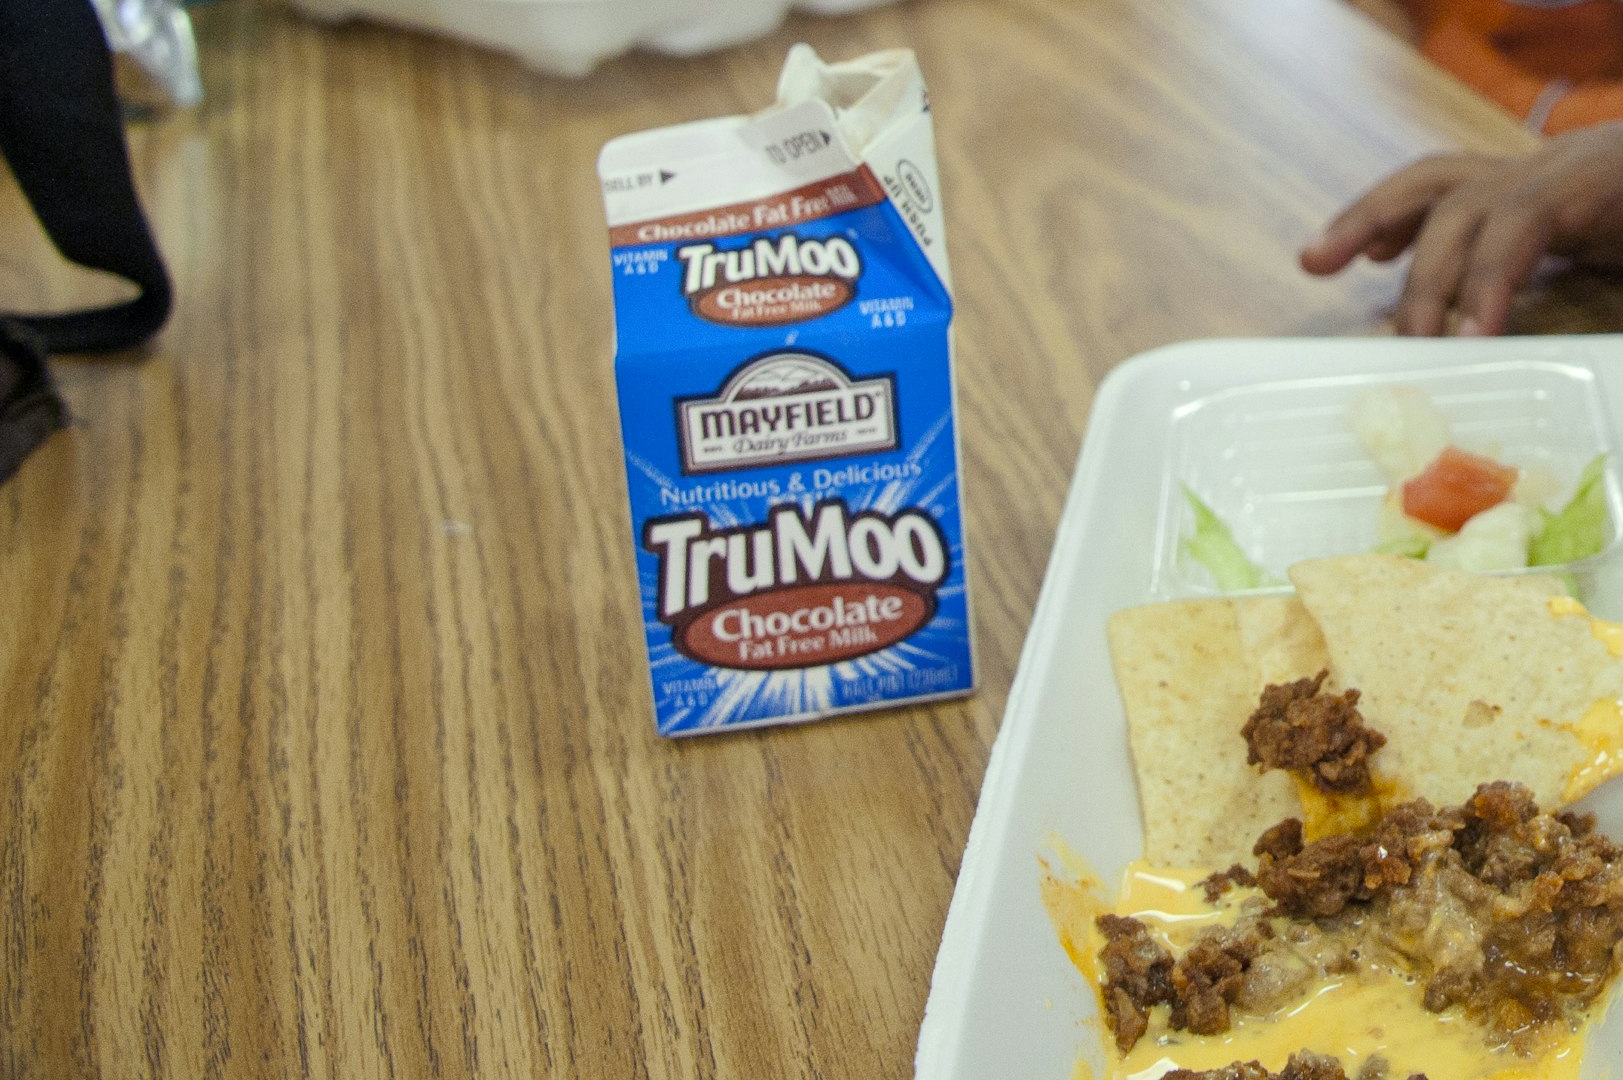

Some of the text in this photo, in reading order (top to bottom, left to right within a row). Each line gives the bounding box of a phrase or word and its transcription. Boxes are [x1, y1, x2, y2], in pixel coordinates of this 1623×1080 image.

[766, 132, 822, 165] TO OPEN
[638, 173, 654, 189] BY
[637, 213, 750, 242] Chocolate
[753, 202, 789, 227] Fat
[791, 195, 830, 219] Free
[613, 249, 668, 267] VITAMIN
[623, 263, 635, 276] A
[648, 261, 659, 274] D
[678, 233, 861, 295] TruMoo
[716, 282, 837, 310] Chocolate
[732, 299, 822, 319] Fat Free Milk
[859, 296, 915, 316] VITAMIN
[871, 312, 883, 329] A
[895, 310, 907, 327] D
[700, 393, 875, 440] MAYFIELD
[733, 435, 790, 456] Dairy
[790, 428, 848, 448] Farms
[661, 461, 923, 506] Nutritious & Delicious
[649, 504, 947, 618] TruMoo
[711, 594, 904, 643] Chocolate
[738, 625, 880, 661] Fat Free Milk
